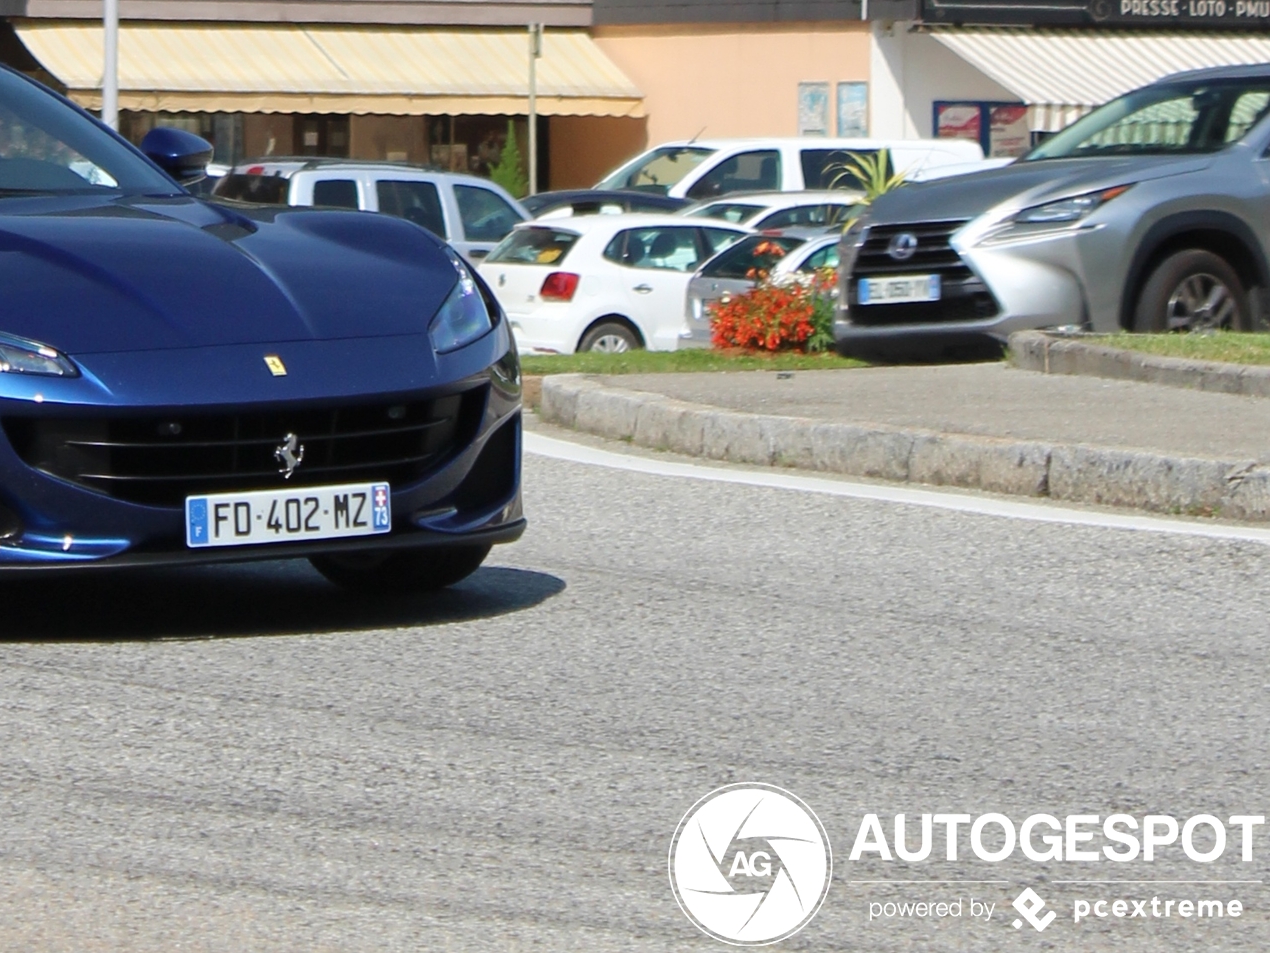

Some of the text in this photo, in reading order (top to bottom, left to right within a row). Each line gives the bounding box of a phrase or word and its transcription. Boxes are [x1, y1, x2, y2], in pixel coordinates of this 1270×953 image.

[1189, 0, 1226, 17] LOTO
[1235, 1, 1270, 18] PMU
[195, 493, 388, 538] F FD-402-MZ 73
